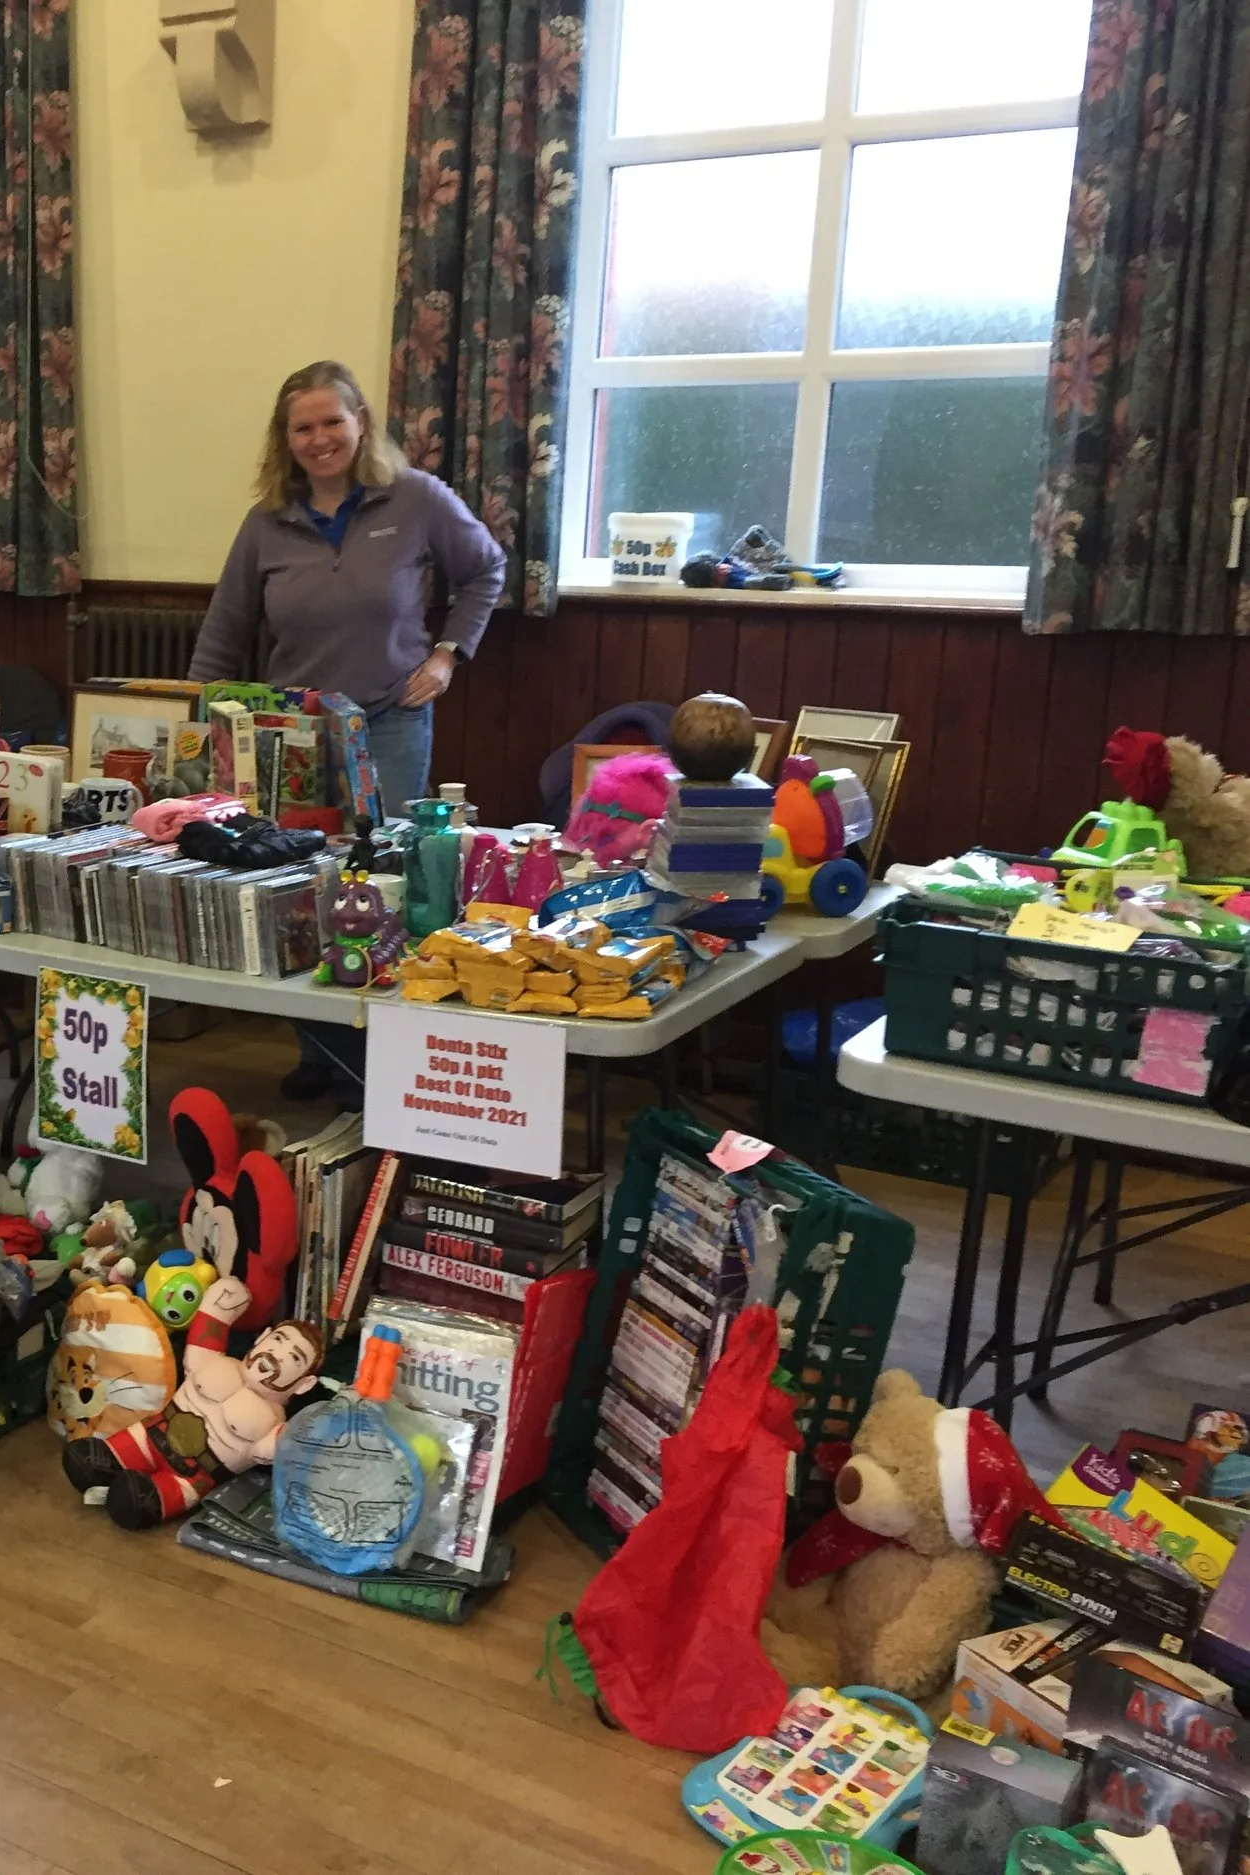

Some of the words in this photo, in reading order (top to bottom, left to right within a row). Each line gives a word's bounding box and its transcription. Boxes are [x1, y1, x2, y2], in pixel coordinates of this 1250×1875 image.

[626, 539, 651, 556] 50p
[62, 1007, 109, 1054] 50p
[428, 1055, 460, 1076] 50p
[462, 1061, 474, 1077] A
[62, 1067, 119, 1109] Stall
[474, 1083, 512, 1103] Date
[403, 1093, 485, 1119] November
[487, 1106, 528, 1127] 2021
[426, 1205, 495, 1235] GERRARD
[424, 1231, 504, 1268] FOWLER
[386, 1246, 422, 1270] ALEX
[426, 1256, 505, 1293] FERGUSON
[397, 1361, 501, 1413] nitting
[1007, 1566, 1070, 1598] ELECTRO
[1070, 1592, 1118, 1620] SYNTH
